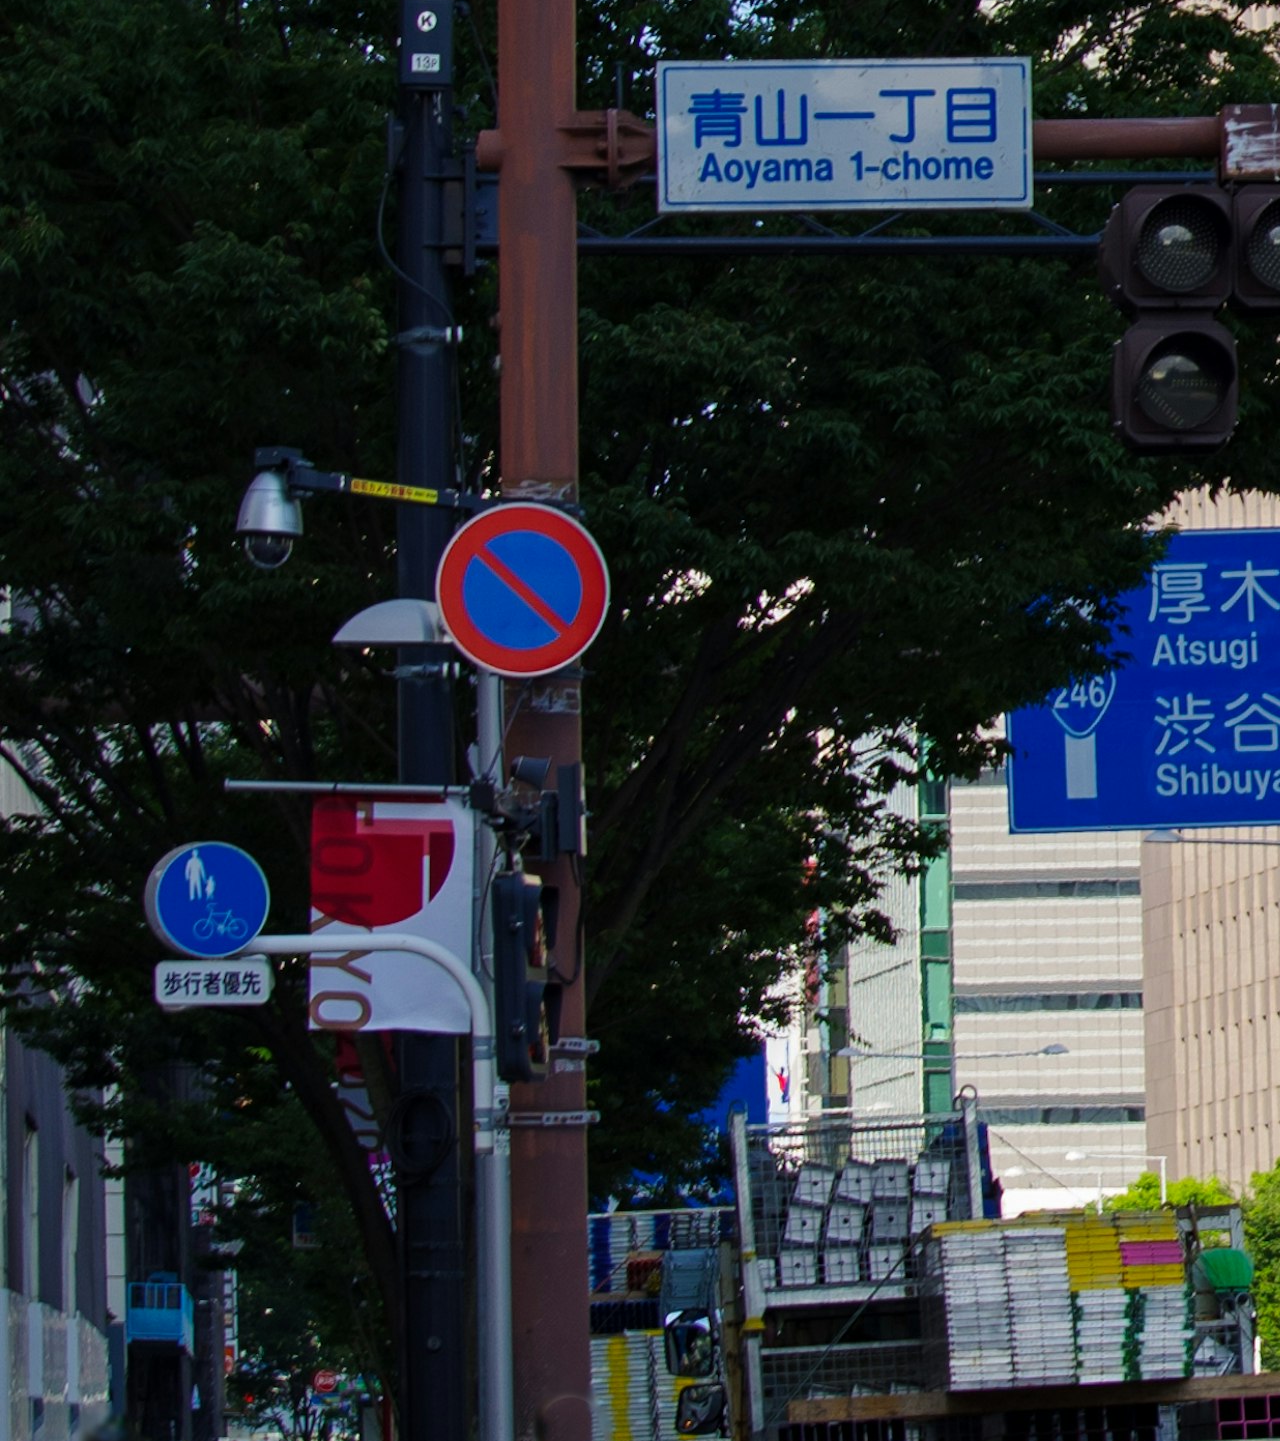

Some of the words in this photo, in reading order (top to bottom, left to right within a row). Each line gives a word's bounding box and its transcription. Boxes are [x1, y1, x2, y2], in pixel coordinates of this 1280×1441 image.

[687, 88, 997, 149] 青山一丁目
[699, 152, 834, 189] Aoyama
[849, 151, 994, 182] 1-chome
[1148, 560, 1280, 624] 厚木
[1152, 632, 1259, 669] Atsugi
[1053, 676, 1106, 708] 246
[164, 971, 262, 996] 歩行者優先
